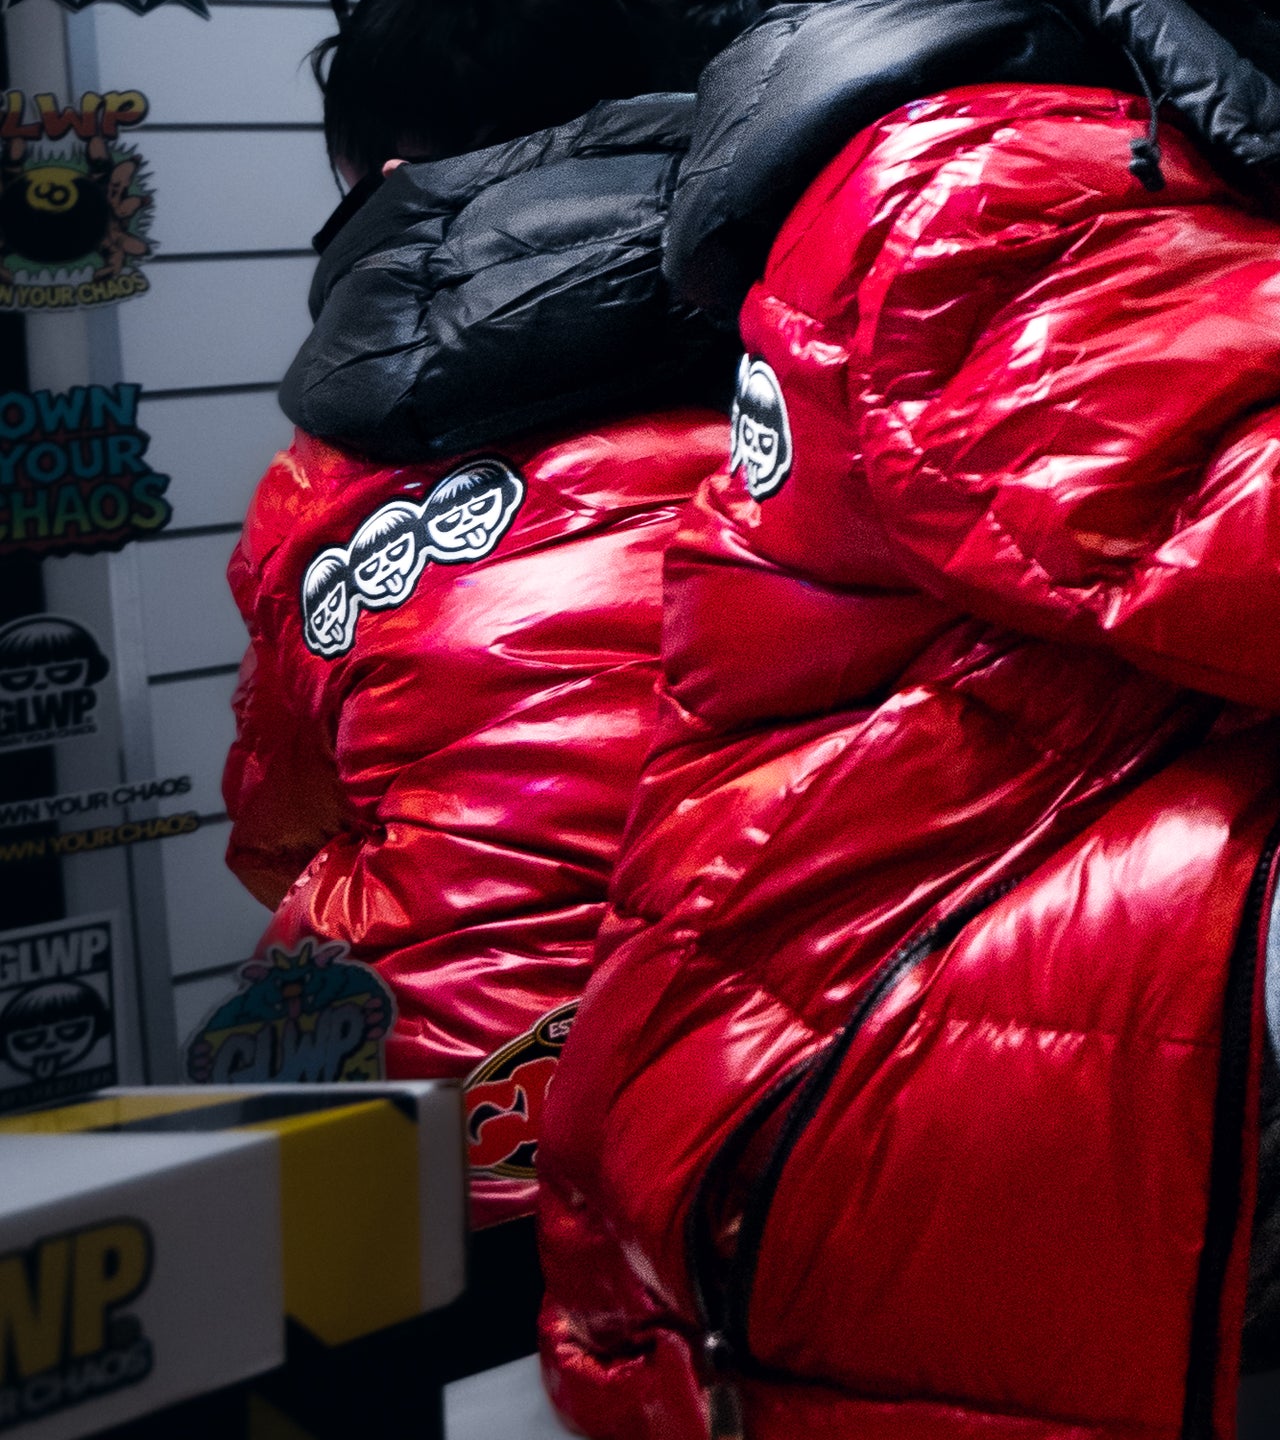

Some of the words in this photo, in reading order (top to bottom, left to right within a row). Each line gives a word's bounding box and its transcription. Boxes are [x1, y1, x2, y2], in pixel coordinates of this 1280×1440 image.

[17, 282, 74, 307] YOUR
[76, 272, 148, 304] CHAOS
[0, 384, 140, 438] OWN
[44, 791, 108, 816] YOUR
[112, 776, 191, 806] CHAOS
[50, 829, 115, 853] YOUR
[115, 814, 198, 842] CHAOS
